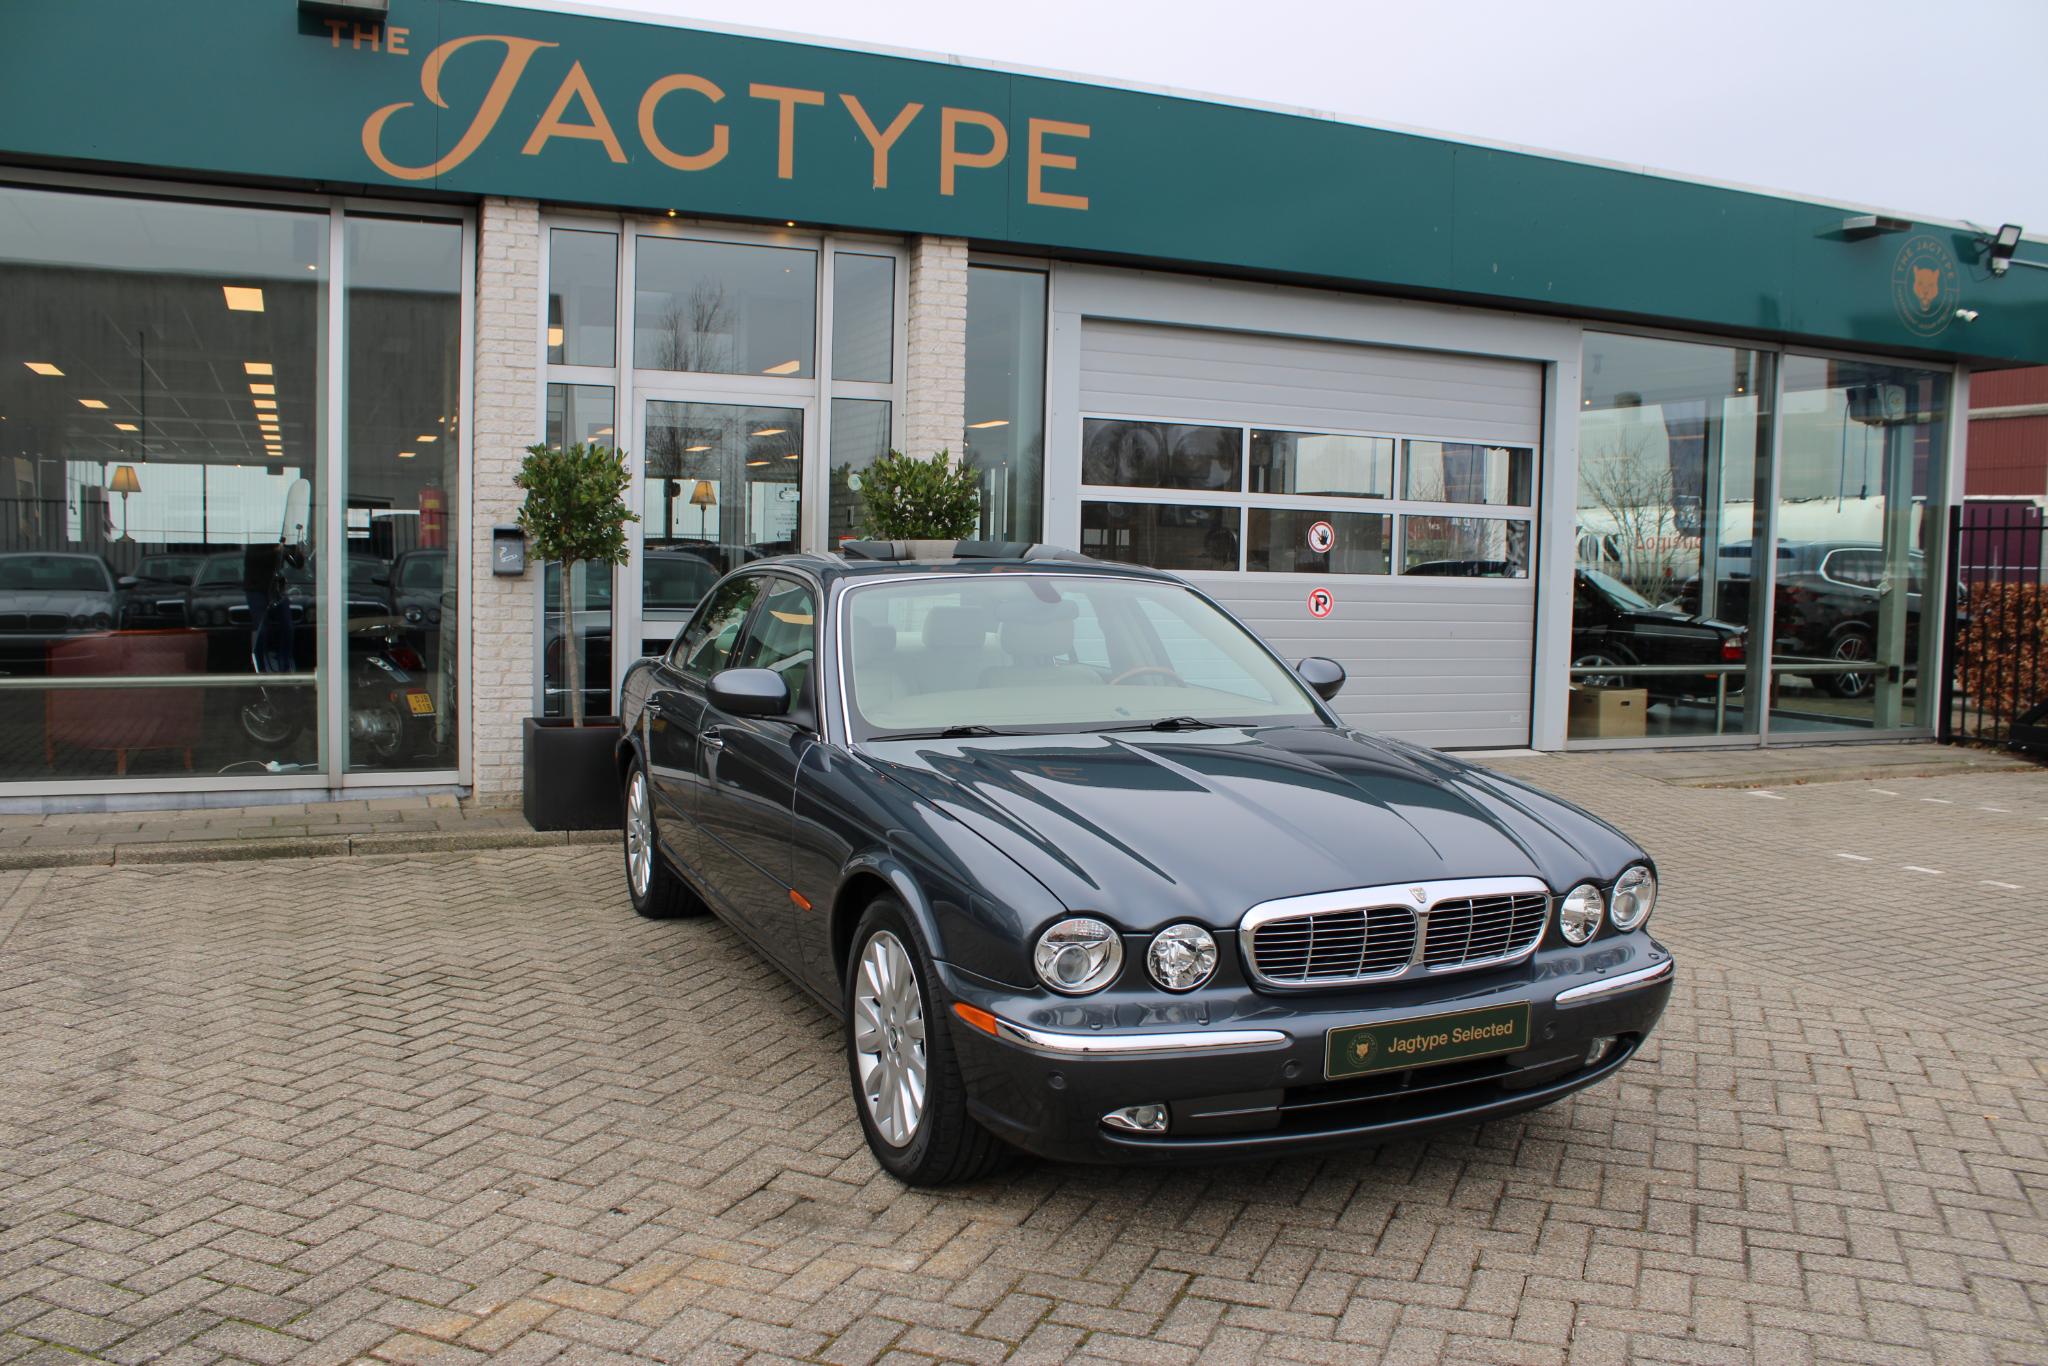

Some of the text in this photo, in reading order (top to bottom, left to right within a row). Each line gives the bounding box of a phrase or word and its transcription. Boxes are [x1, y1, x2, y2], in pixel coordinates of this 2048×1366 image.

[324, 19, 1091, 210] THE JAGTYPE
[1388, 1033, 1448, 1055] Jagtype
[1452, 1020, 1514, 1044] Selected
